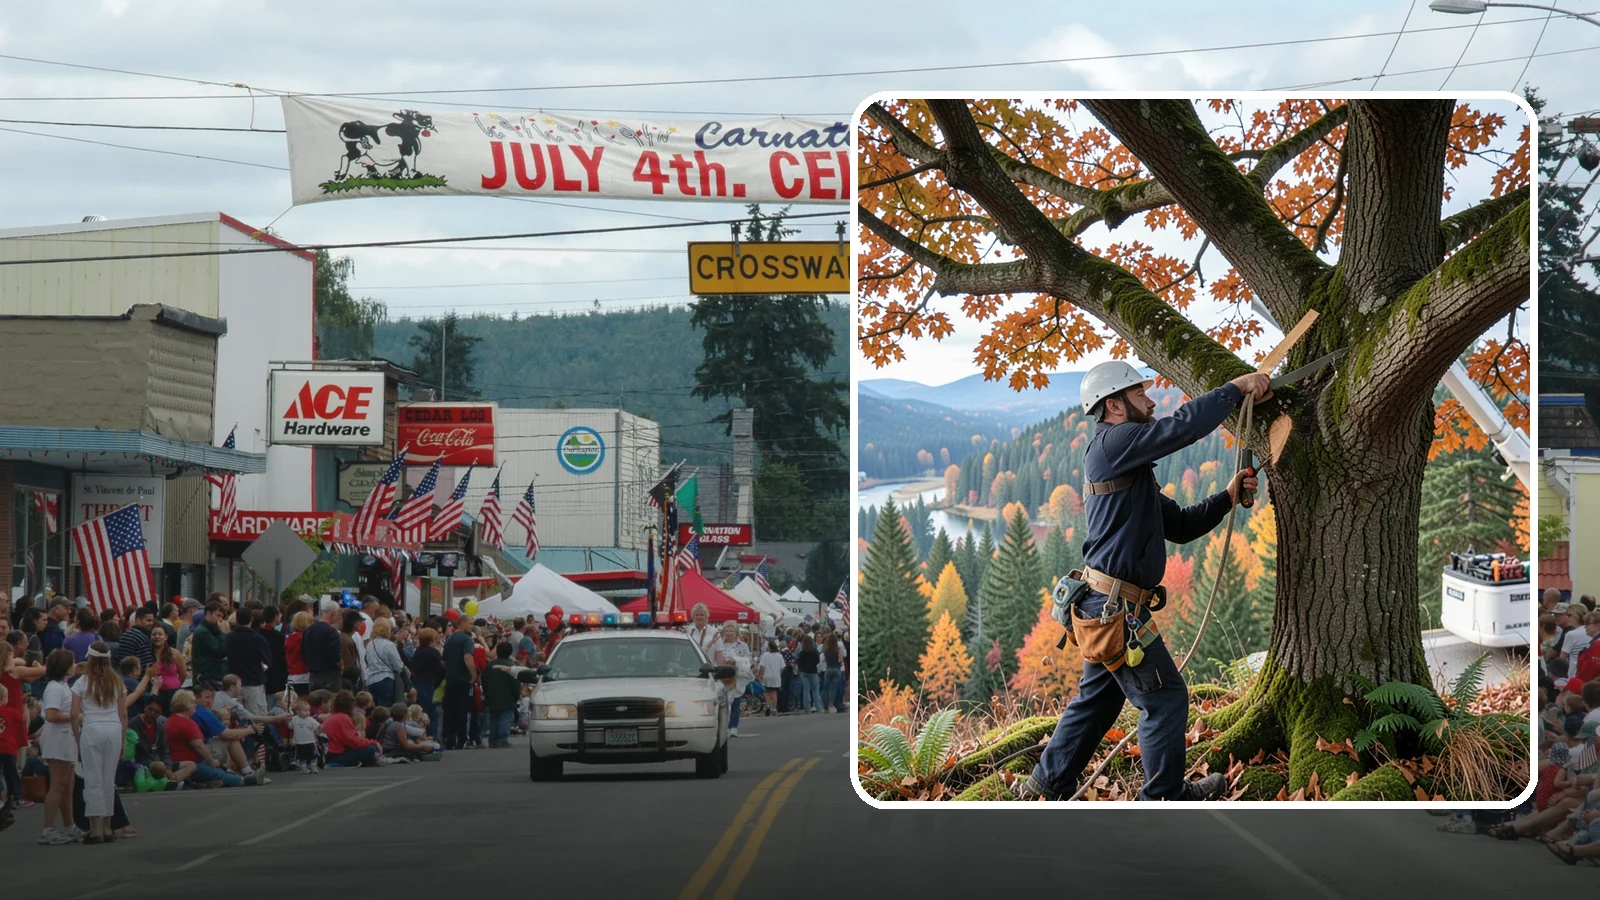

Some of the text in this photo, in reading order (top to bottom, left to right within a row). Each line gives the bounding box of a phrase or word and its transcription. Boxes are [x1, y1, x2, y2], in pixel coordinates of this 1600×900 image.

[695, 121, 850, 150] Carnat
[481, 141, 605, 193] JULY
[632, 149, 746, 198] 4th.
[697, 254, 850, 280] CROSSWA
[283, 380, 374, 420] ACE
[405, 409, 453, 422] CEDAR
[283, 421, 371, 437] Hardware
[416, 428, 477, 447] Coca-Cola
[95, 485, 124, 495] Vincent
[126, 486, 136, 495] de
[138, 486, 155, 495] Paul
[81, 503, 154, 522] THT
[688, 526, 741, 535] CRNATION
[699, 535, 730, 543] GLASS
